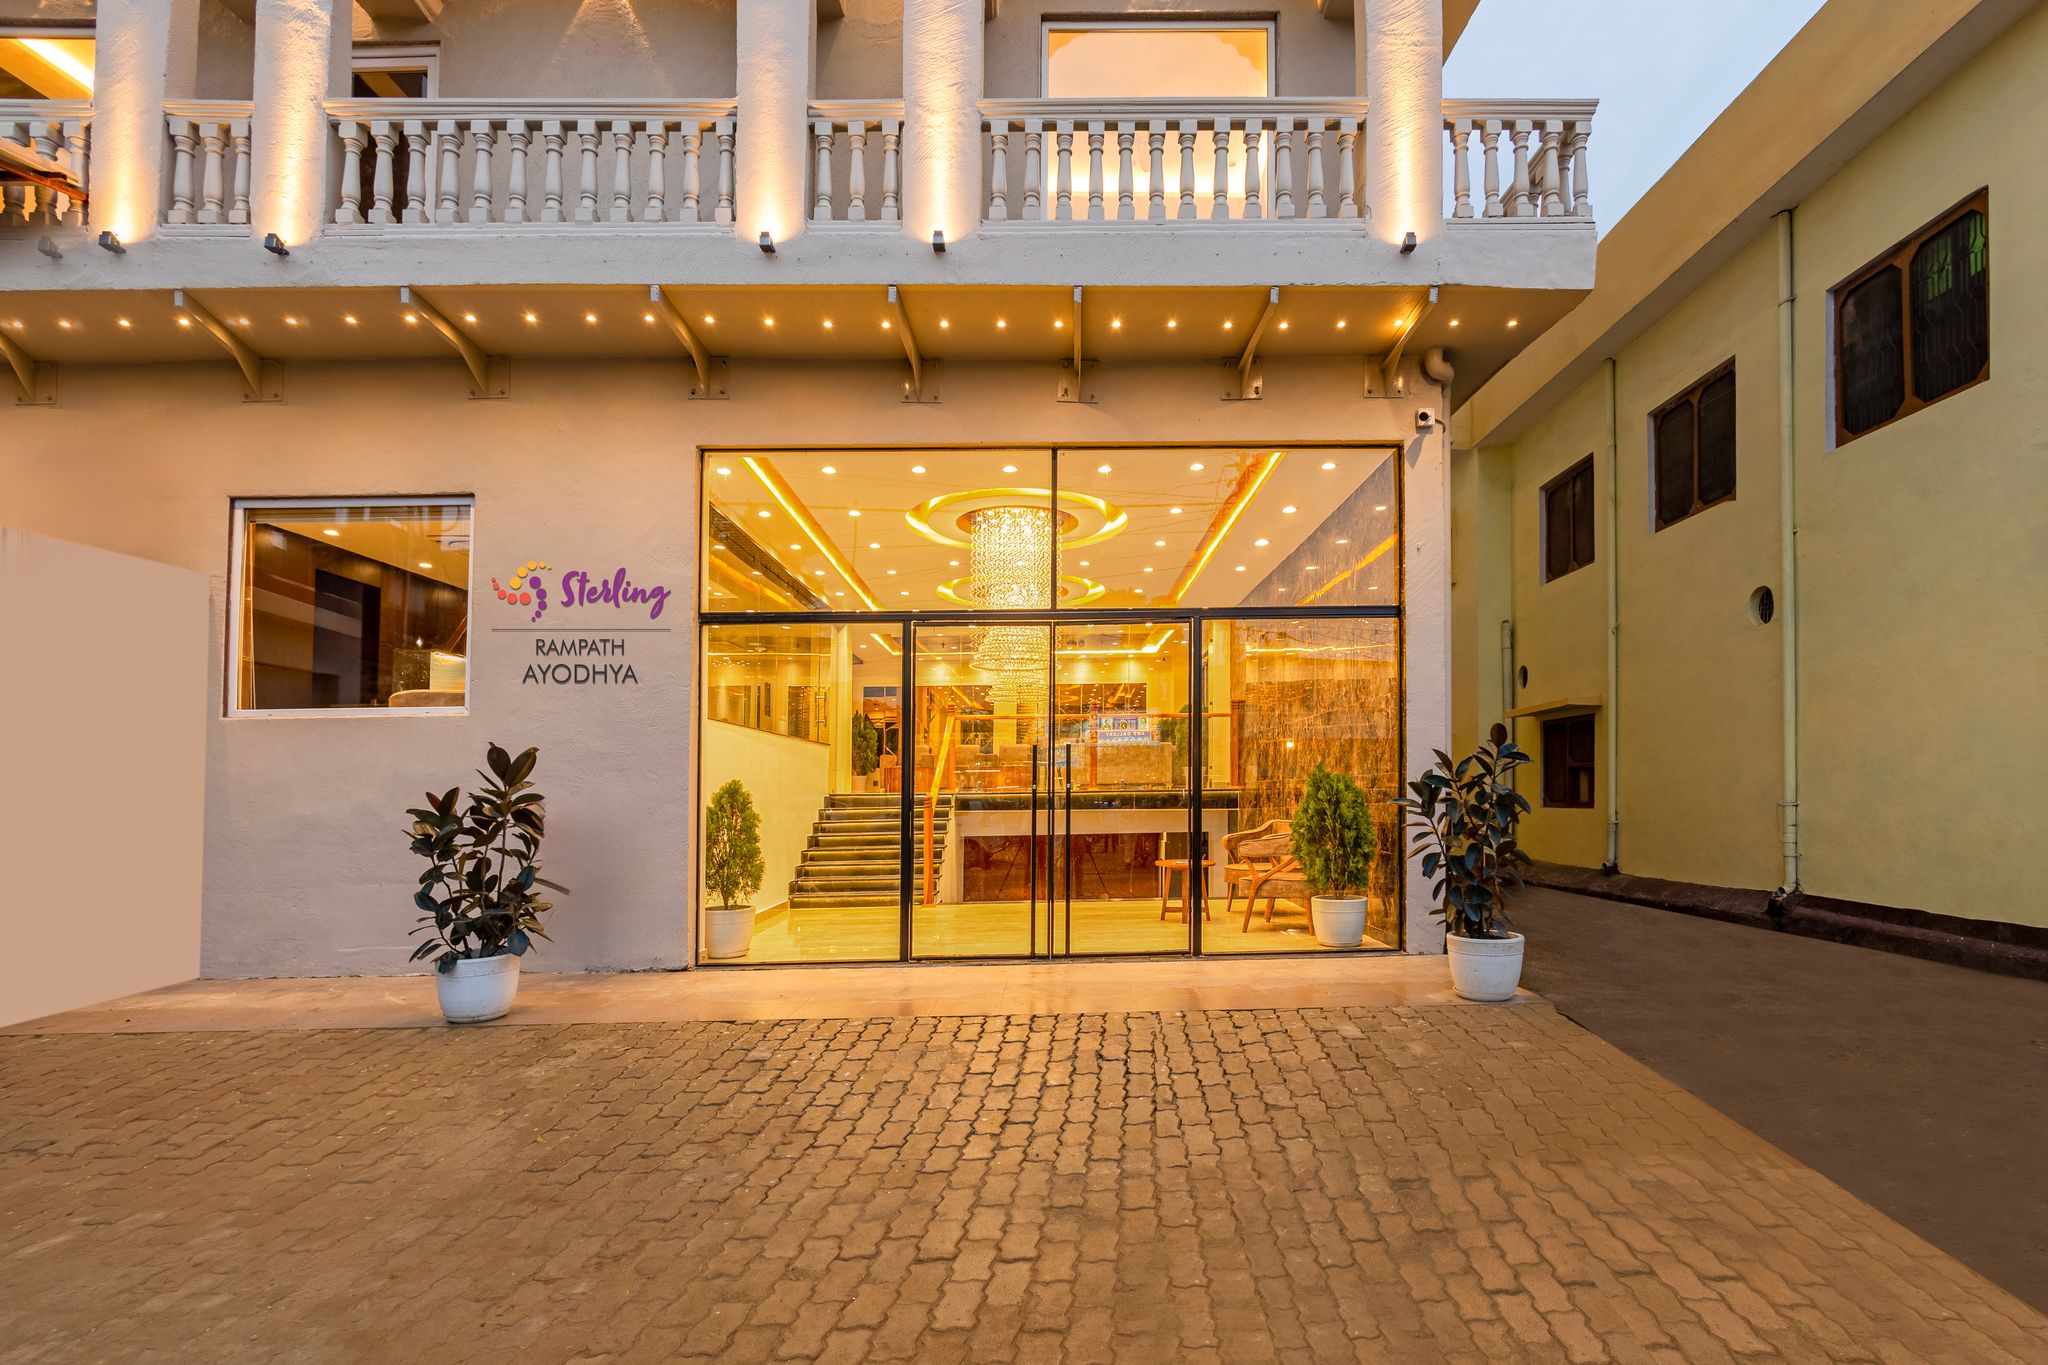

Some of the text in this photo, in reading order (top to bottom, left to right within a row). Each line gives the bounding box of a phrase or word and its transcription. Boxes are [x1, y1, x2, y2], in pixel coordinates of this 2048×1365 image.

[561, 567, 671, 620] Sterling
[535, 638, 625, 656] RAMPATH
[522, 664, 639, 685] AYODHYA
